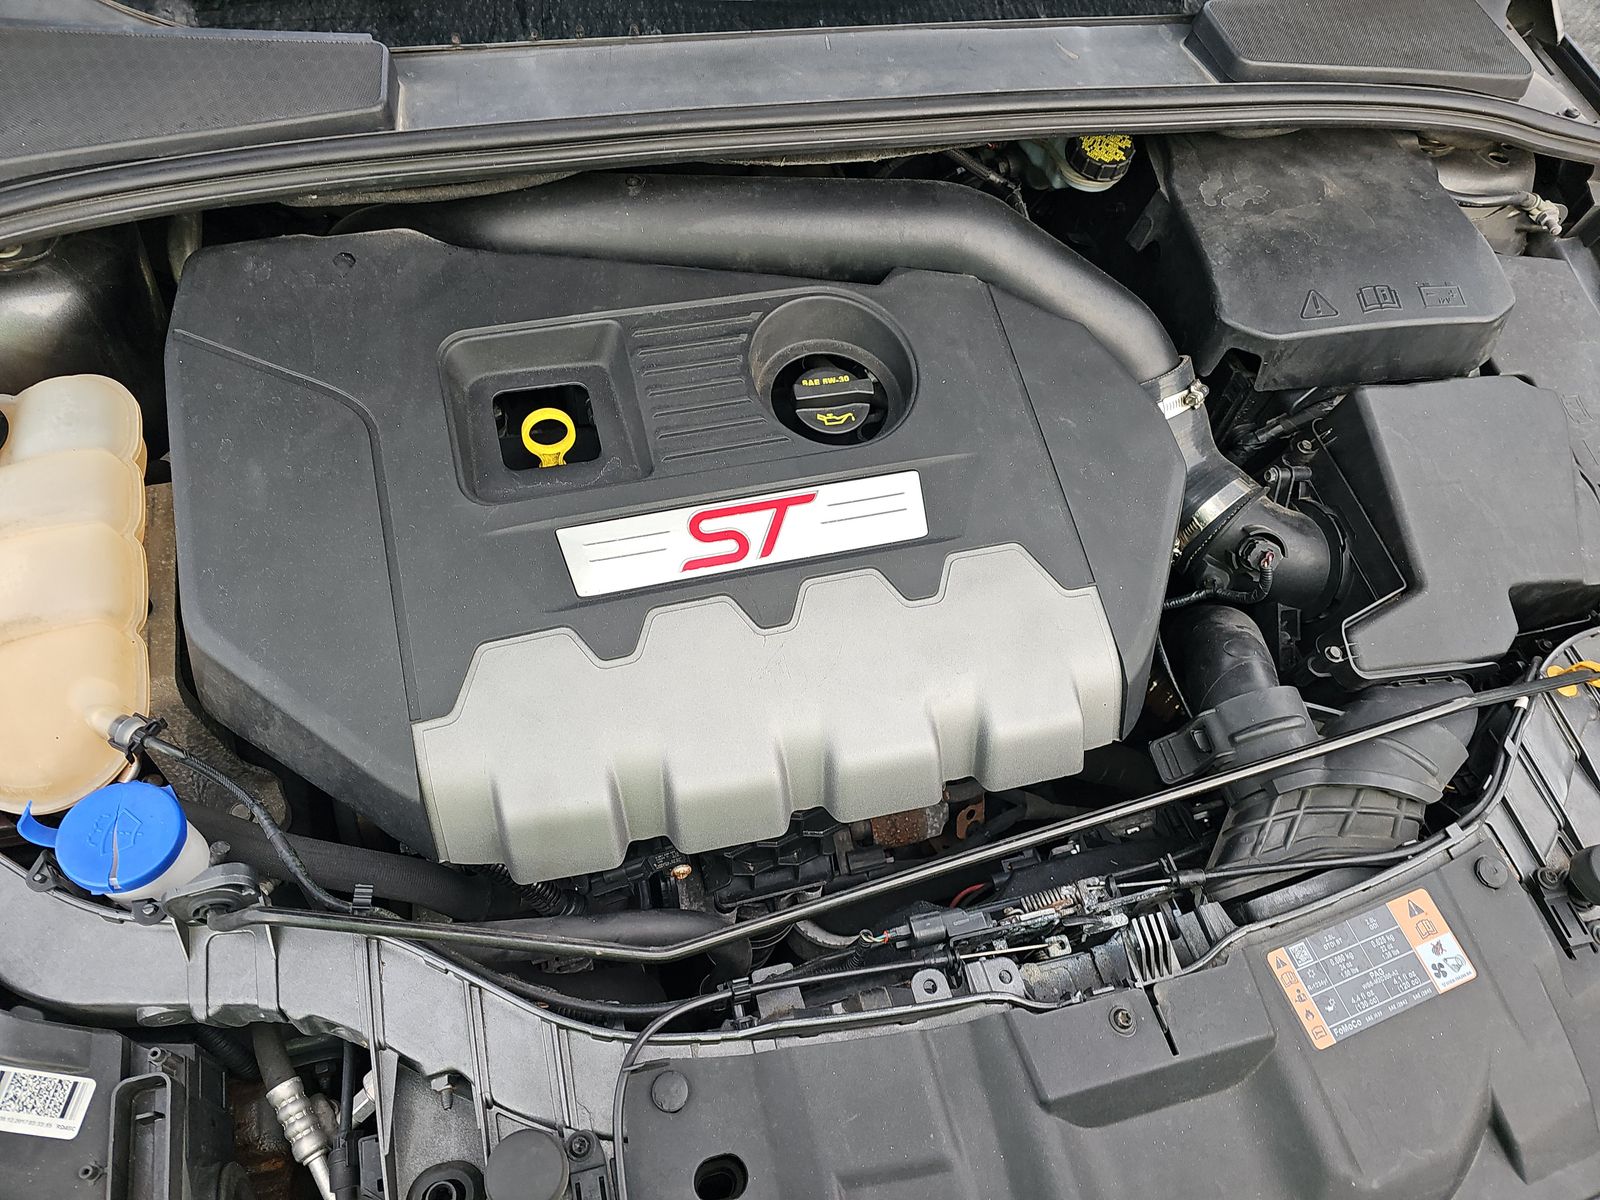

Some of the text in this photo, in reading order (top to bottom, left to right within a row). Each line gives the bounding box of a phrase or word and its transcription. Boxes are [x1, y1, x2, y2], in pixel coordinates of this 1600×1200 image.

[801, 378, 820, 387] SAE
[680, 490, 819, 573] ST
[1386, 934, 1396, 942] kg
[1345, 952, 1355, 960] kg
[1338, 963, 1347, 971] 24
[1369, 968, 1385, 979] PAG
[1393, 975, 1404, 985] 4.1
[1408, 971, 1417, 979] oz
[1397, 977, 1421, 993] (120 cc)
[1351, 994, 1362, 1004] 4.4
[1366, 989, 1375, 998] oz
[1355, 995, 1381, 1012] (130 cc)
[1332, 1019, 1362, 1037] FoMoCo
